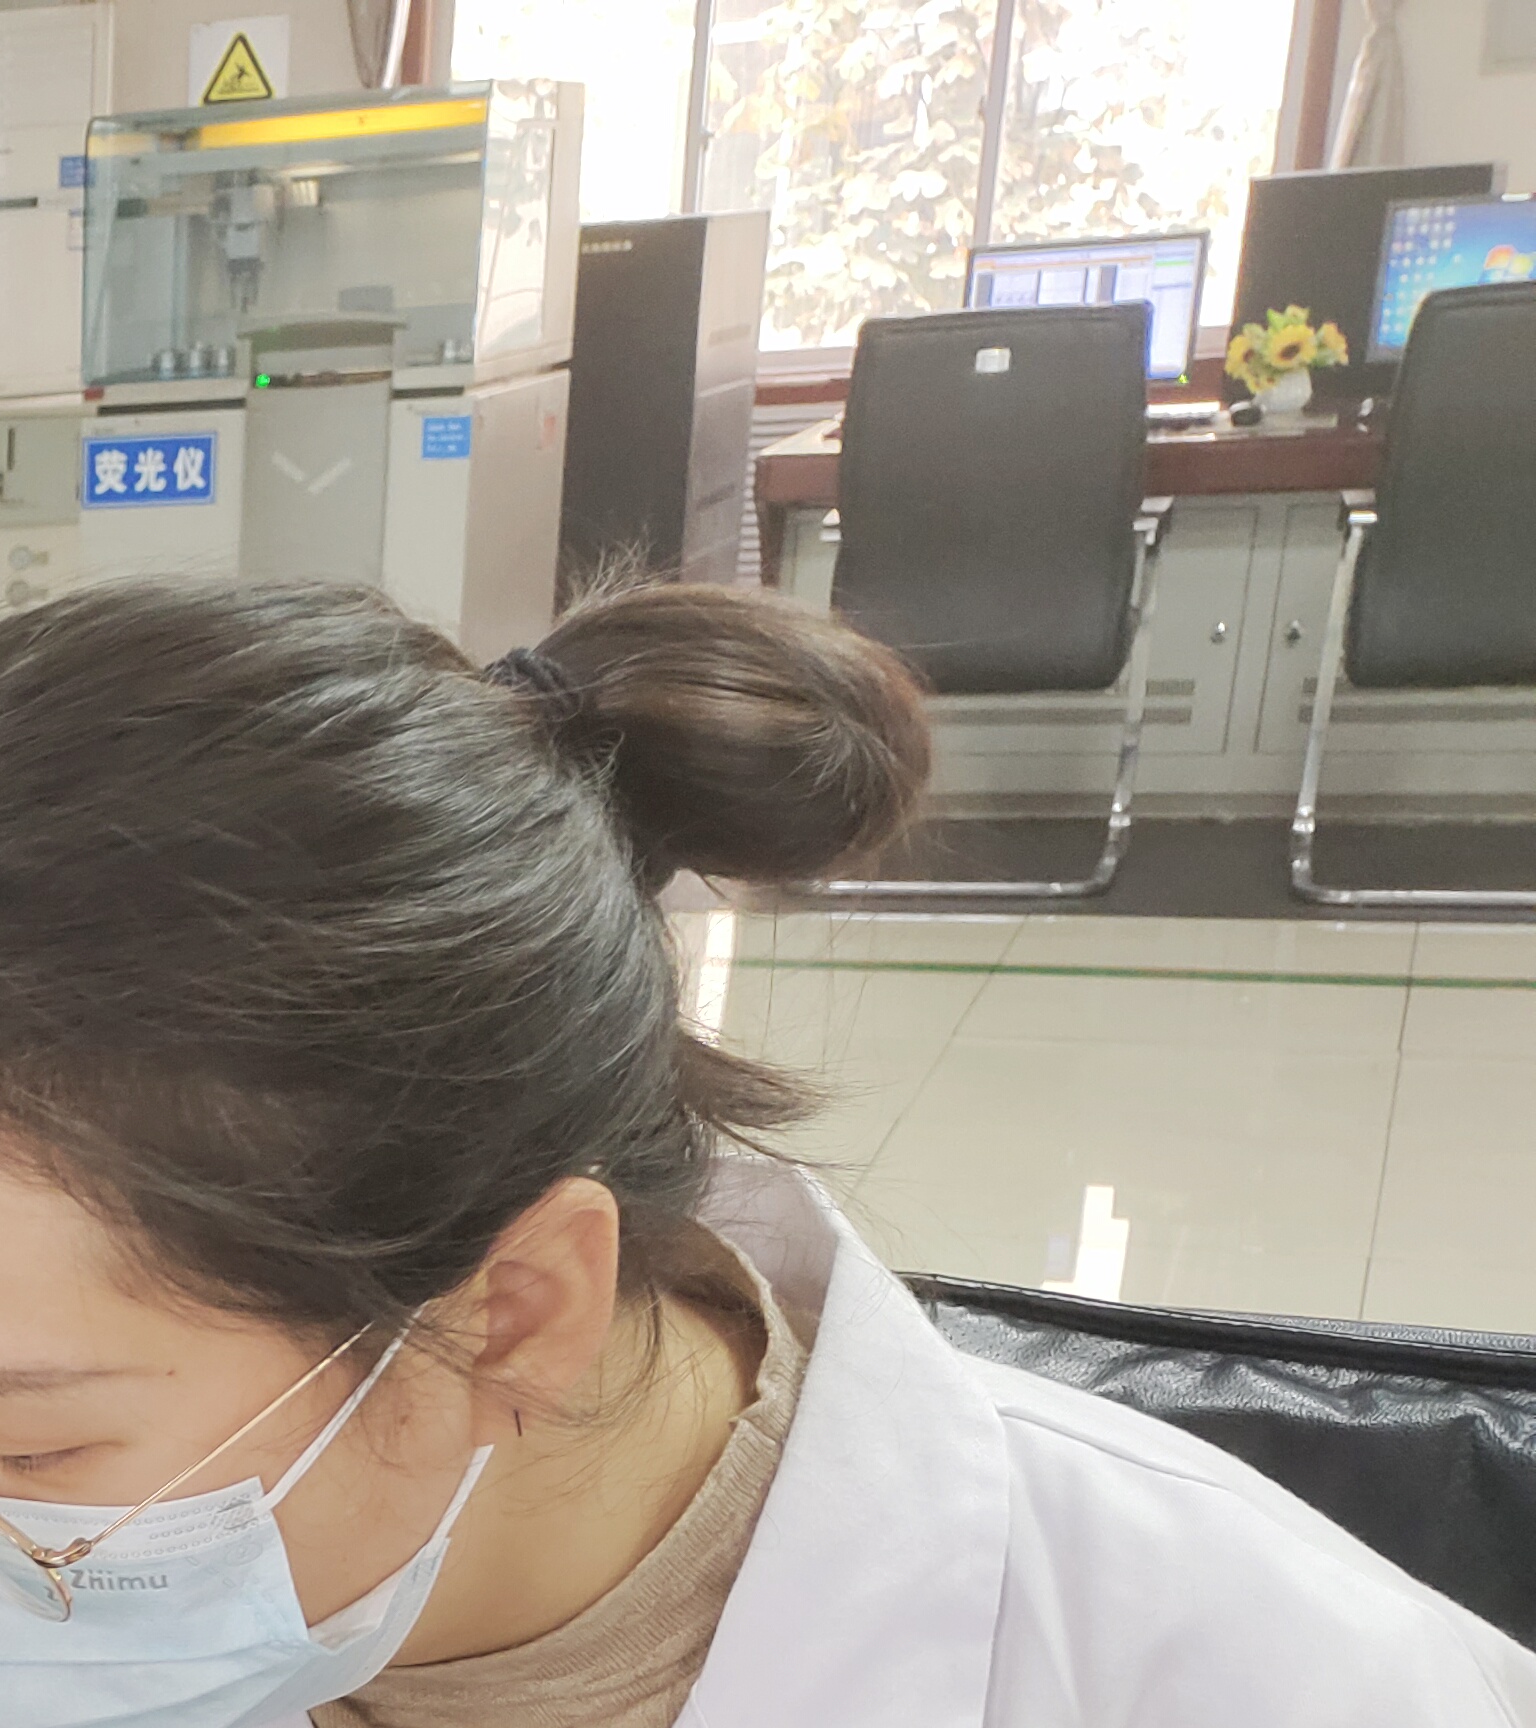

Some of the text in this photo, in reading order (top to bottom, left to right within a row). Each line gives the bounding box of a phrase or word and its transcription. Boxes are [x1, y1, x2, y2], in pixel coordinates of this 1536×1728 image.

[95, 447, 206, 495] 荧光仪
[70, 1568, 168, 1590] Zhimu
